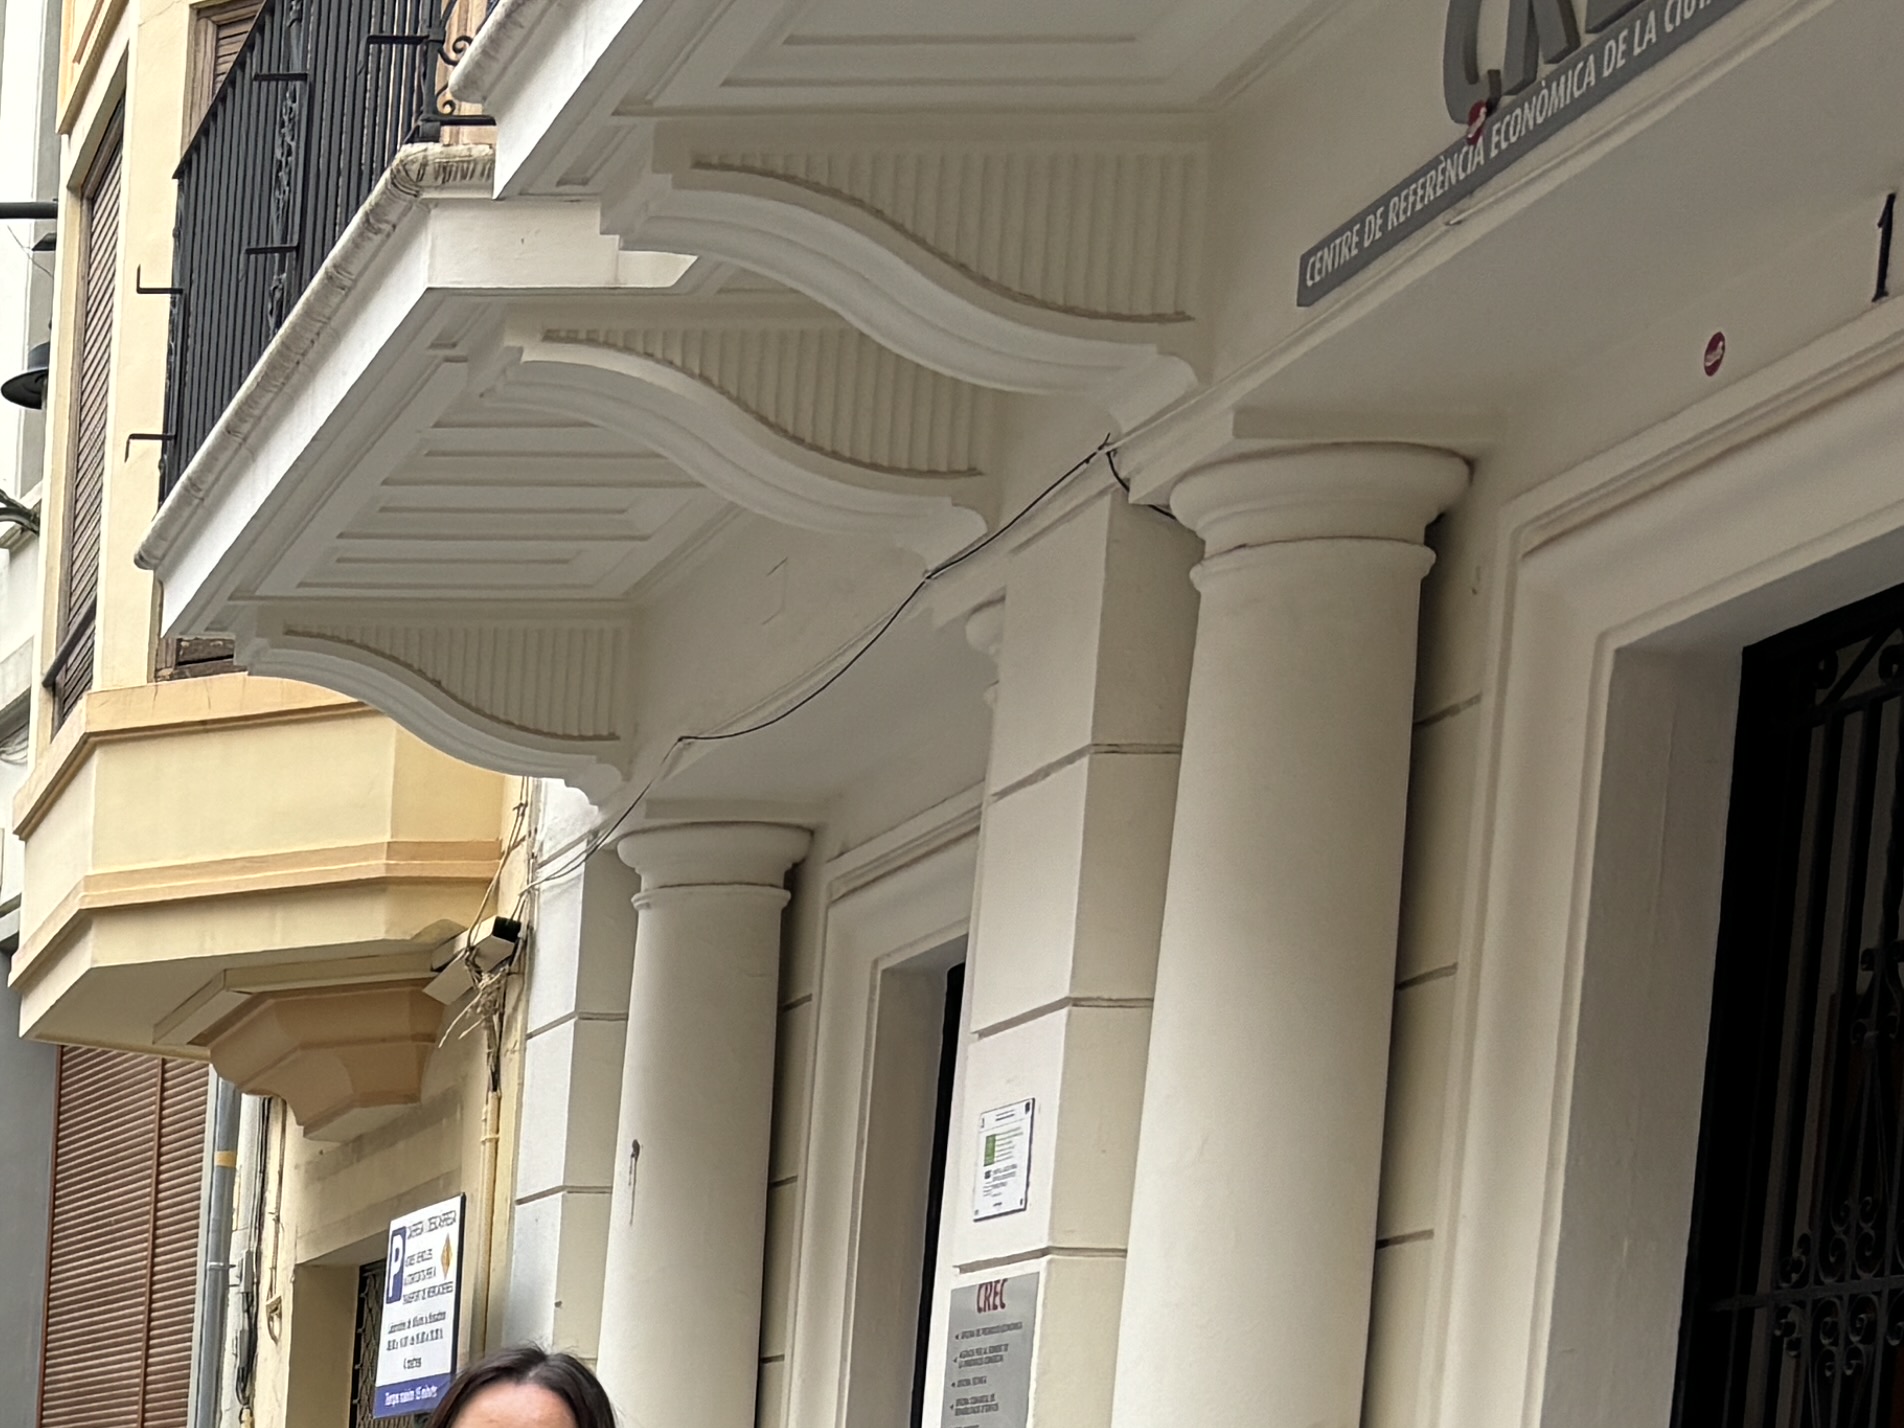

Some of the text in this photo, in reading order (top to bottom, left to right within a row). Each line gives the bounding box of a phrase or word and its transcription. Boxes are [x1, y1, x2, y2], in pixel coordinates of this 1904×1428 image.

[1306, 223, 1360, 287] CENTRE
[1364, 206, 1384, 248] DE
[1387, 135, 1485, 231] REFERÈNCIA
[1490, 54, 1596, 159] ECONÒMICA
[1603, 28, 1628, 77] DE
[1633, 9, 1657, 56] LA
[977, 1278, 1008, 1313] CREC
